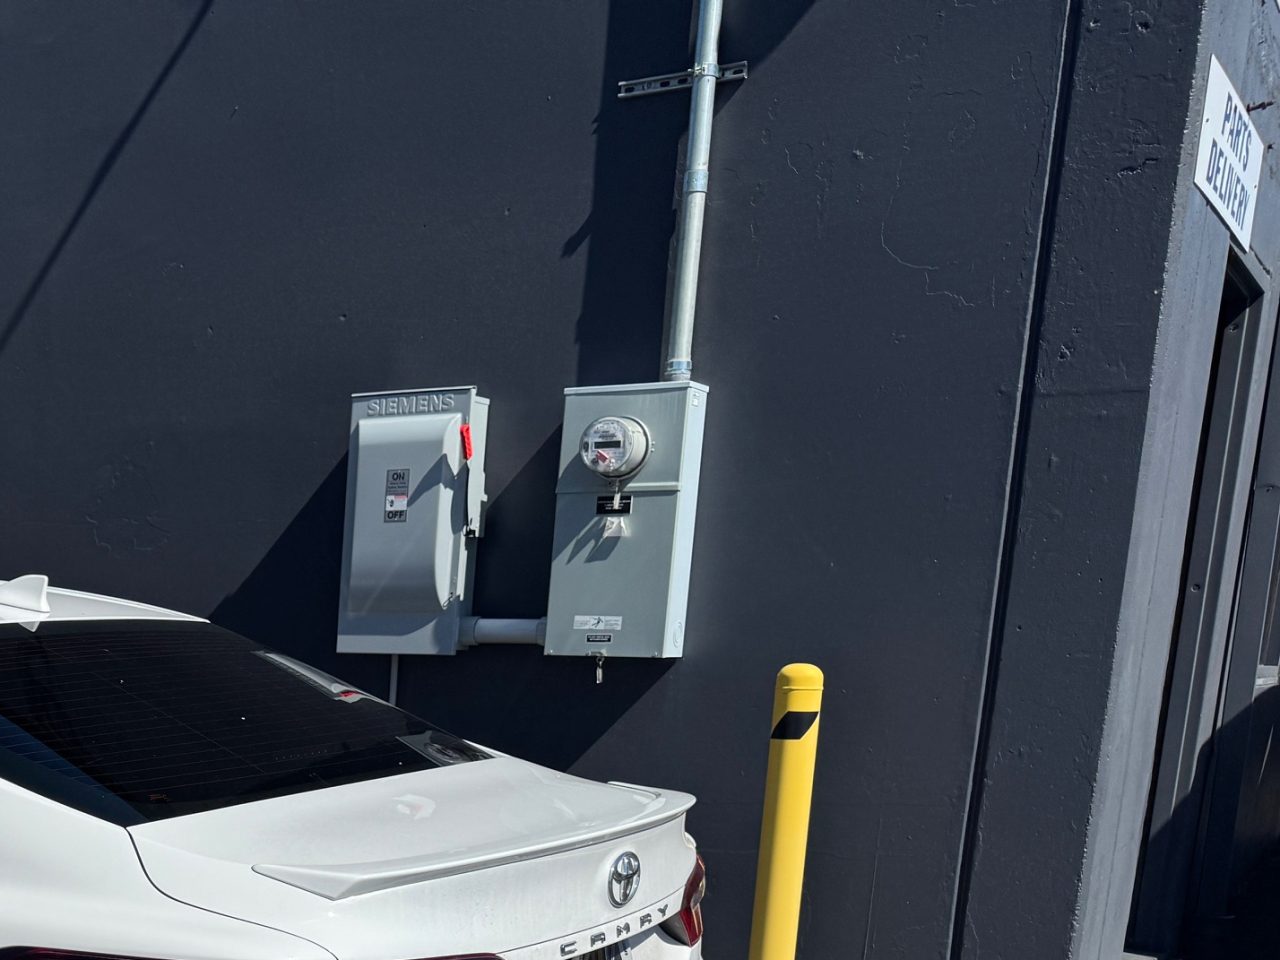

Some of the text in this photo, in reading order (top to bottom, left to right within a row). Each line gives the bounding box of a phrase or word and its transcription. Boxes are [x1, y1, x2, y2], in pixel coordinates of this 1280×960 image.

[1222, 91, 1252, 172] PARTS
[1206, 137, 1250, 231] DELIVERY
[367, 393, 455, 417] SIEMENS
[392, 472, 405, 481] ON
[387, 510, 405, 520] OFF
[559, 903, 669, 958] CAMRY
